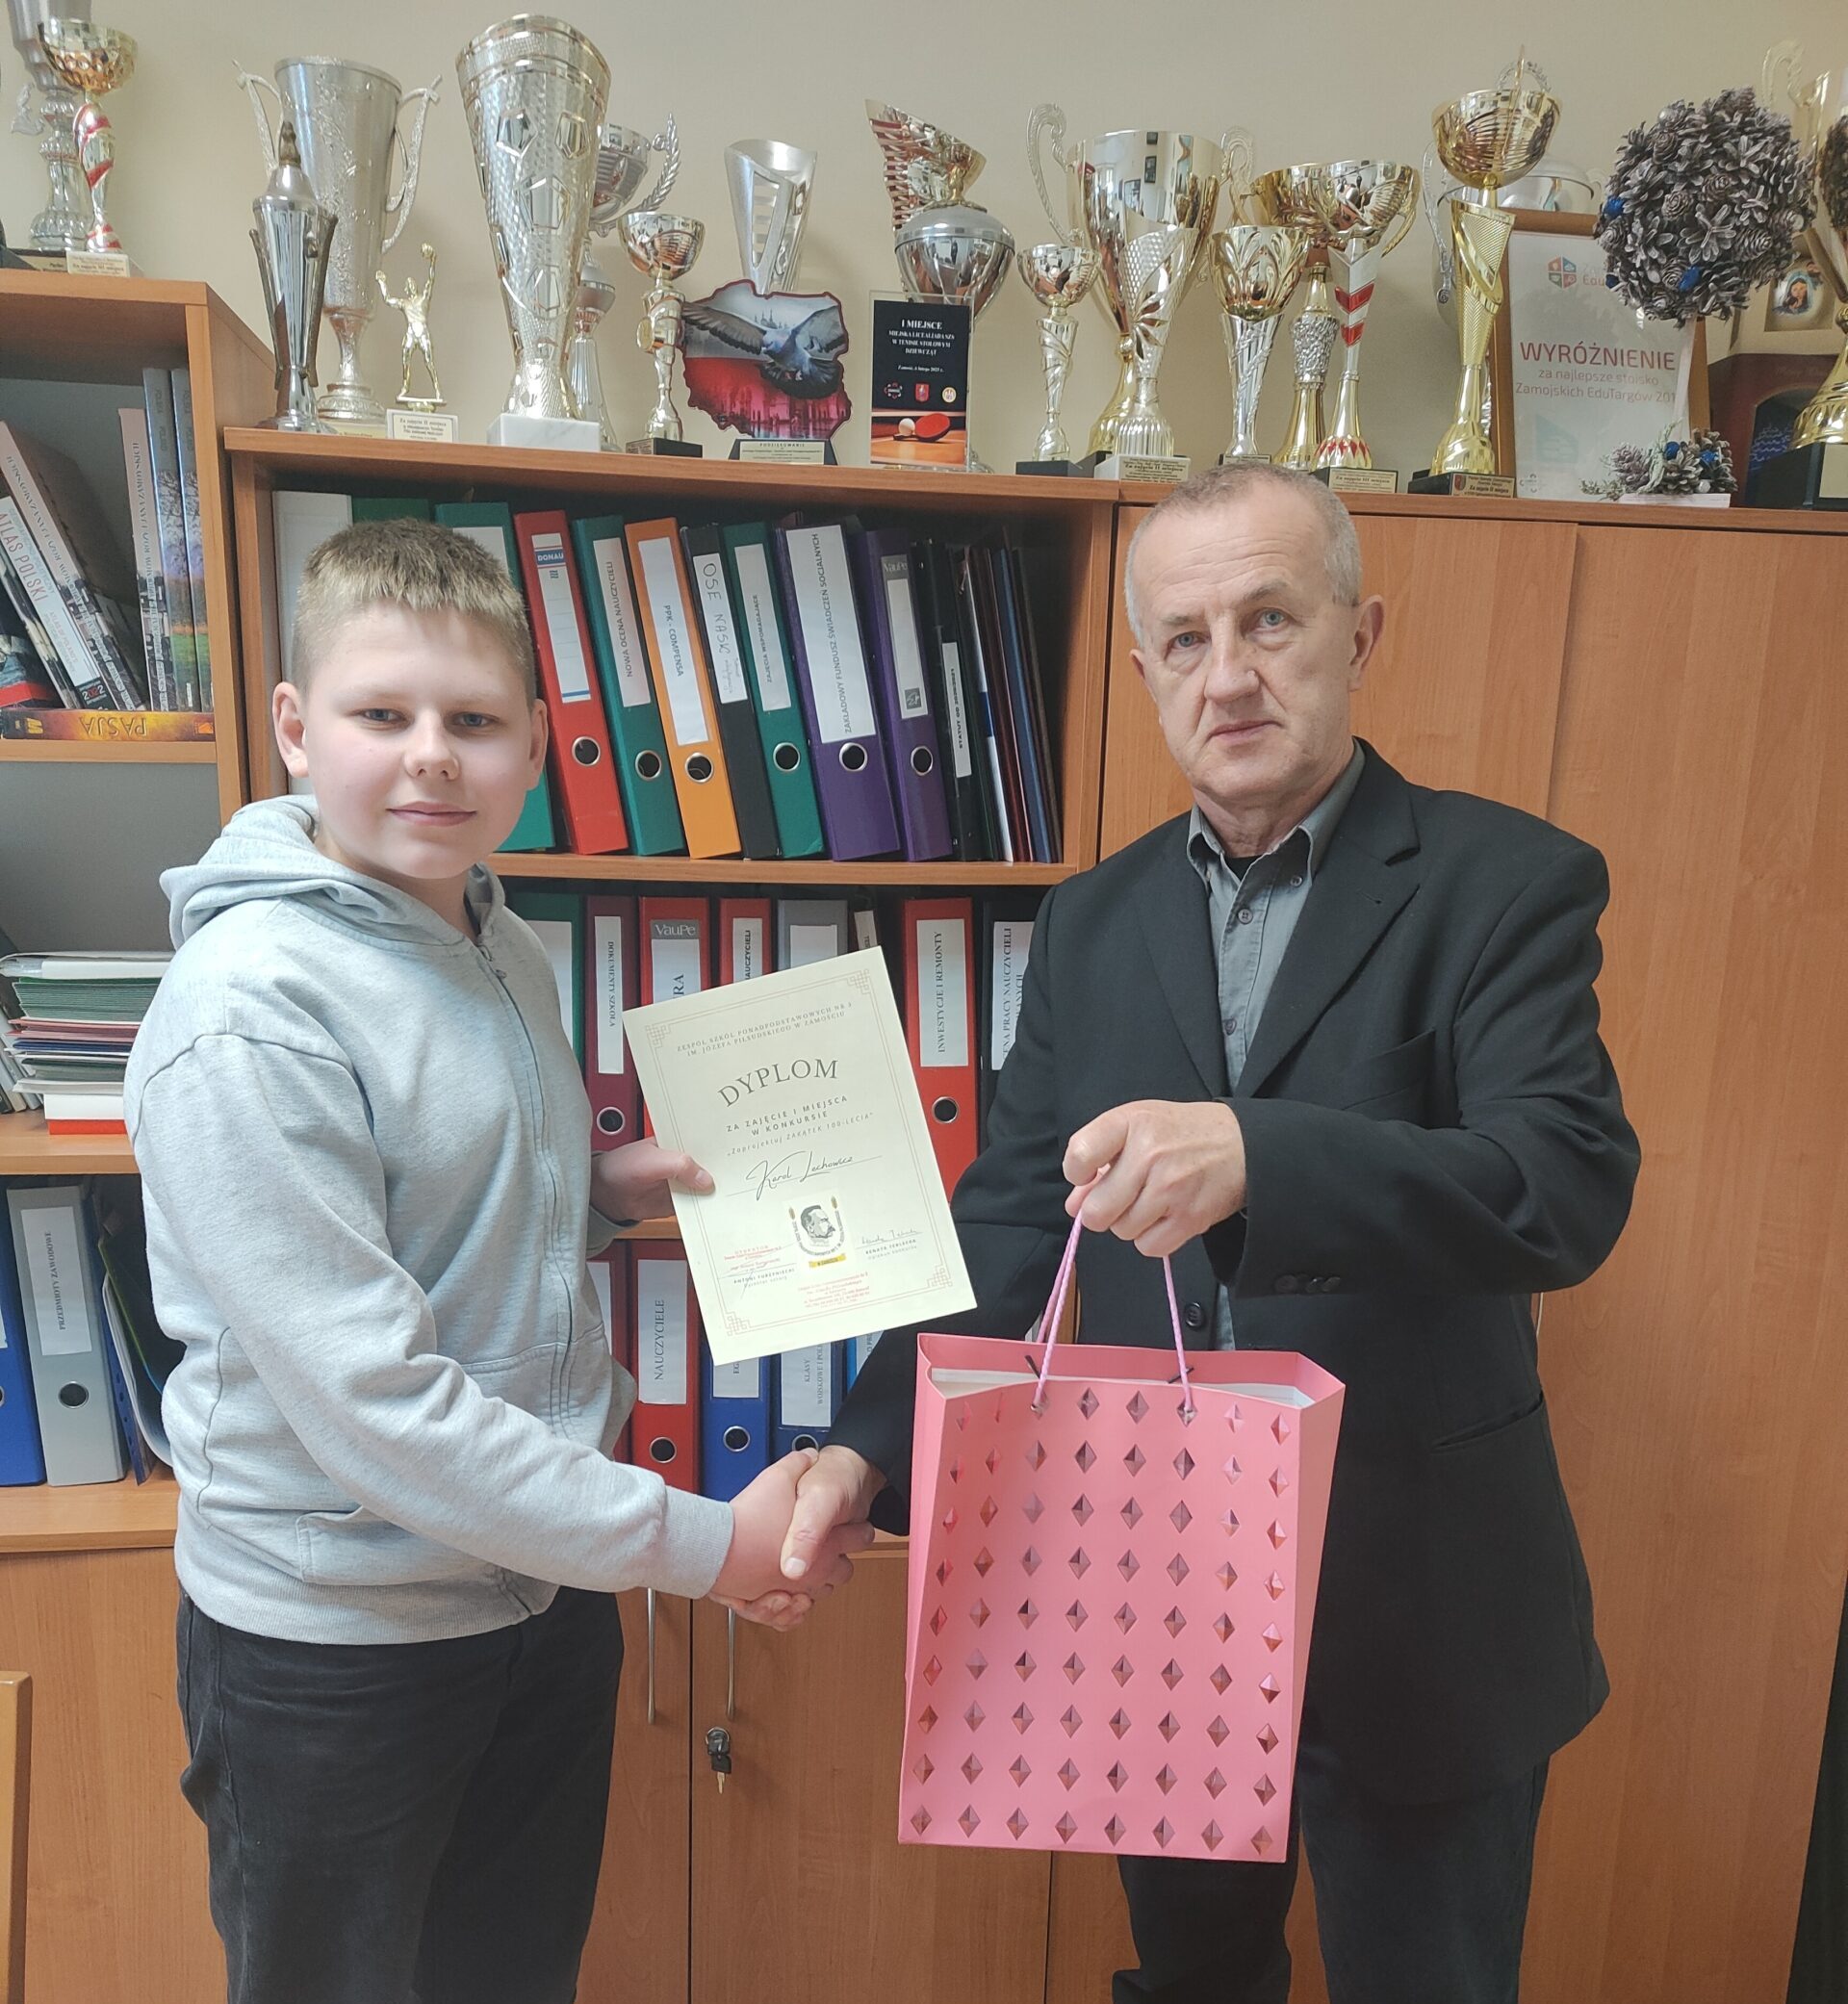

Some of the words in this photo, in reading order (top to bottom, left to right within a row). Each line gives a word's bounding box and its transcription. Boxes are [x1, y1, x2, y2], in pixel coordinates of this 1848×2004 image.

[901, 319, 905, 328] I
[907, 320, 943, 330] MIEJSCE
[1520, 341, 1677, 371] WYRÓŻNIENIE
[1515, 383, 1584, 398] Zamojskich
[1587, 387, 1653, 403] EduTargów
[1656, 391, 1676, 402] 201
[1538, 370, 1553, 379] za
[1555, 368, 1615, 385] najlepsze
[1615, 373, 1659, 386] stoisko
[0, 512, 23, 558] ATLAS
[14, 554, 48, 602] POLSKI
[537, 552, 564, 562] DONAU
[812, 533, 828, 588] SOCJALNYCH
[606, 561, 622, 616] NAUCZYCIELI
[703, 562, 722, 601] OSE
[663, 604, 674, 623] PPK
[820, 589, 835, 639] ŚWIADCZEŃ
[616, 619, 628, 648] OCENA
[621, 649, 633, 678] NOWA
[668, 628, 683, 678] COMPENSA
[830, 641, 843, 680] FUNDUSZ
[82, 683, 106, 701] 2022
[837, 682, 852, 733] ZAKŁADOWY
[79, 716, 148, 737] PASJA
[654, 924, 696, 936] VauPe
[934, 932, 943, 982] REMONTY
[1003, 928, 1013, 997] NAUCZYCIELI
[673, 974, 685, 995] RA
[936, 990, 946, 1053] INWESTYCJE
[1003, 999, 1012, 1032] PRACY
[717, 1059, 839, 1108] DYPLOM
[726, 1123, 740, 1133] ZA
[745, 1111, 788, 1128] ZAJĘCIE
[803, 1095, 849, 1113] MIEJSCA
[751, 1128, 760, 1137] W
[765, 1111, 829, 1133] KONKURSIE
[786, 1126, 823, 1142] ZAKĄTEK
[745, 1150, 808, 1201] Karol
[799, 1150, 855, 1183] Lechowicz
[44, 1231, 59, 1278] ZAWODOWE
[51, 1280, 65, 1330] PRZEDMIOTY
[654, 1298, 666, 1381] NAUCZYCIELE
